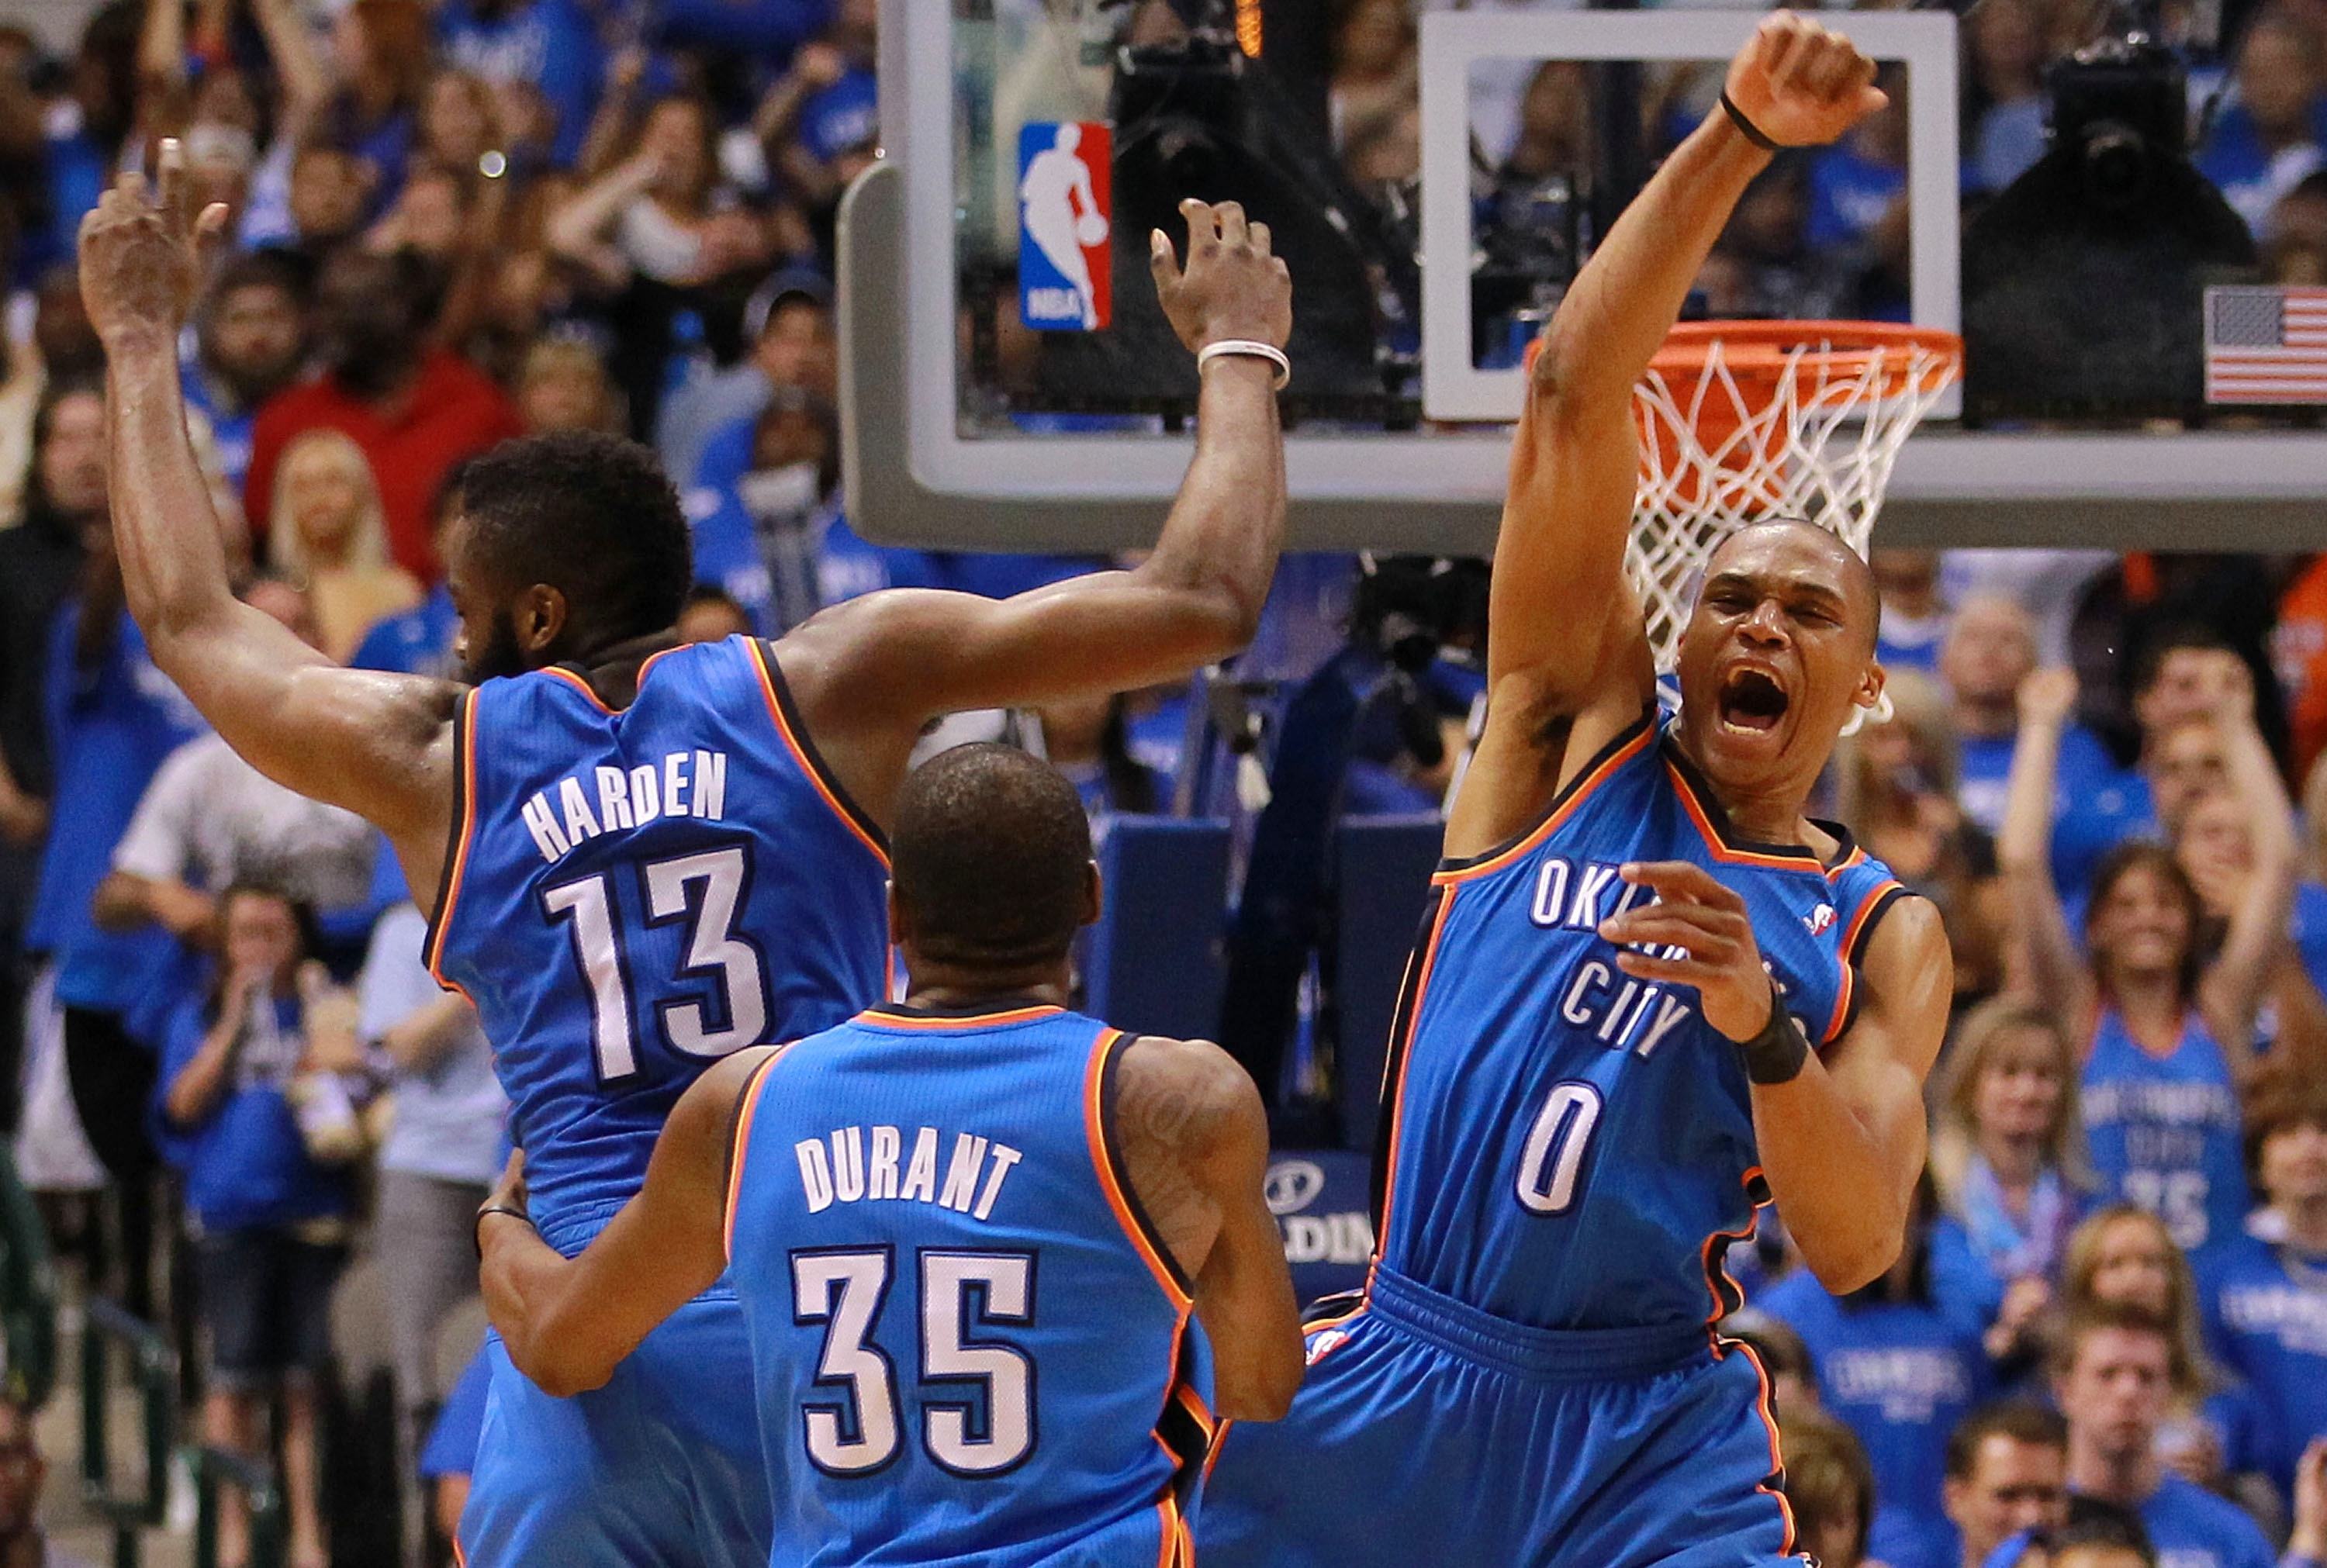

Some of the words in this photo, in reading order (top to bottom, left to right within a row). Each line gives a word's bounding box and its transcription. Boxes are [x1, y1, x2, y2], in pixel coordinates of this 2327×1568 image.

[1028, 288, 1082, 319] NBA
[520, 749, 728, 864] HARDEN
[543, 846, 768, 1081] 13
[1561, 959, 1691, 1058] CITY
[794, 1124, 1023, 1221] DURANT
[1516, 1082, 1602, 1212] 0
[790, 1249, 1036, 1475] 35
